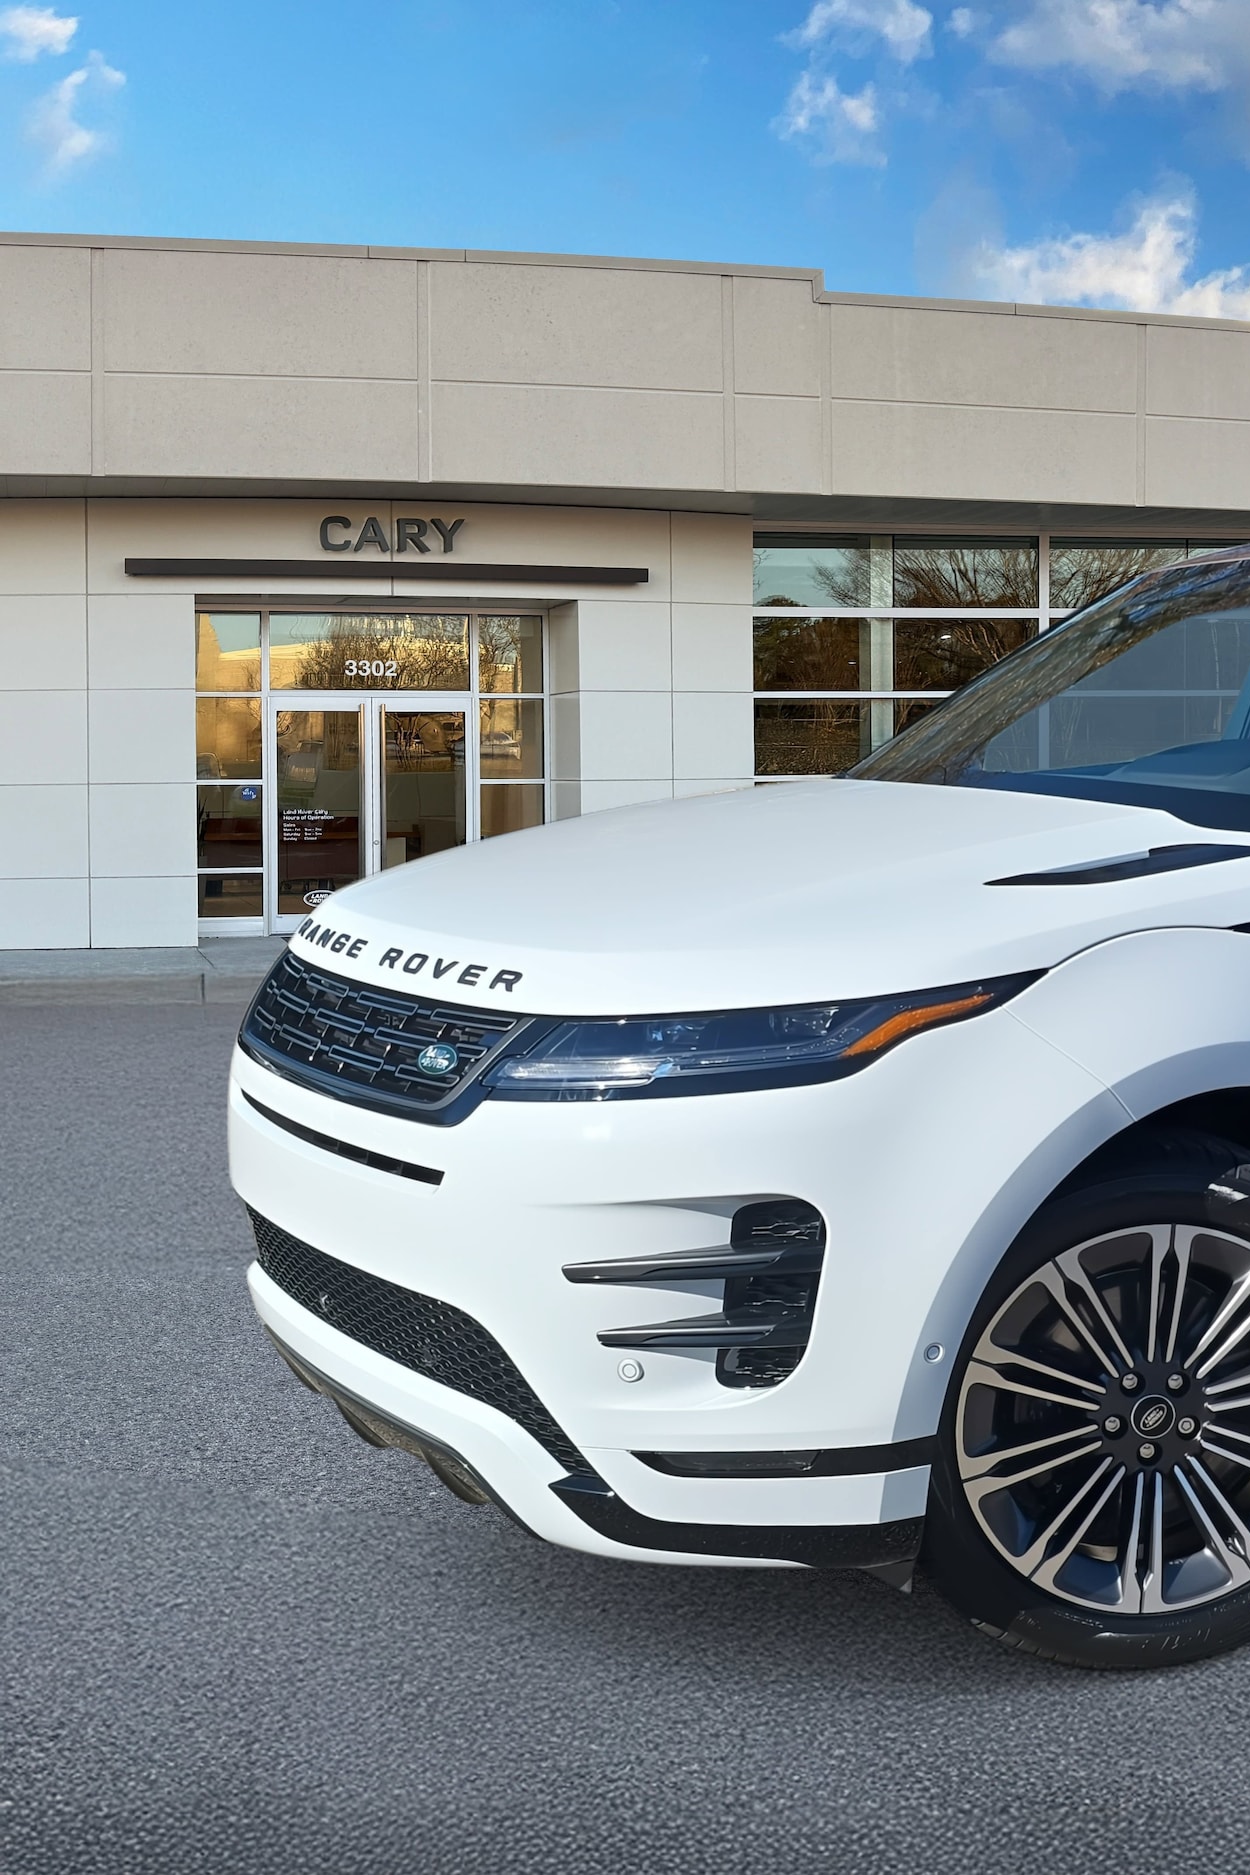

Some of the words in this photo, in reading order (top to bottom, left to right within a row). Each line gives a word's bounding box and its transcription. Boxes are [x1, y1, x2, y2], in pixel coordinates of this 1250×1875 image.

[319, 515, 465, 554] CARY
[344, 659, 398, 677] 3302
[298, 917, 369, 959] RANGE
[379, 947, 524, 993] ROVER
